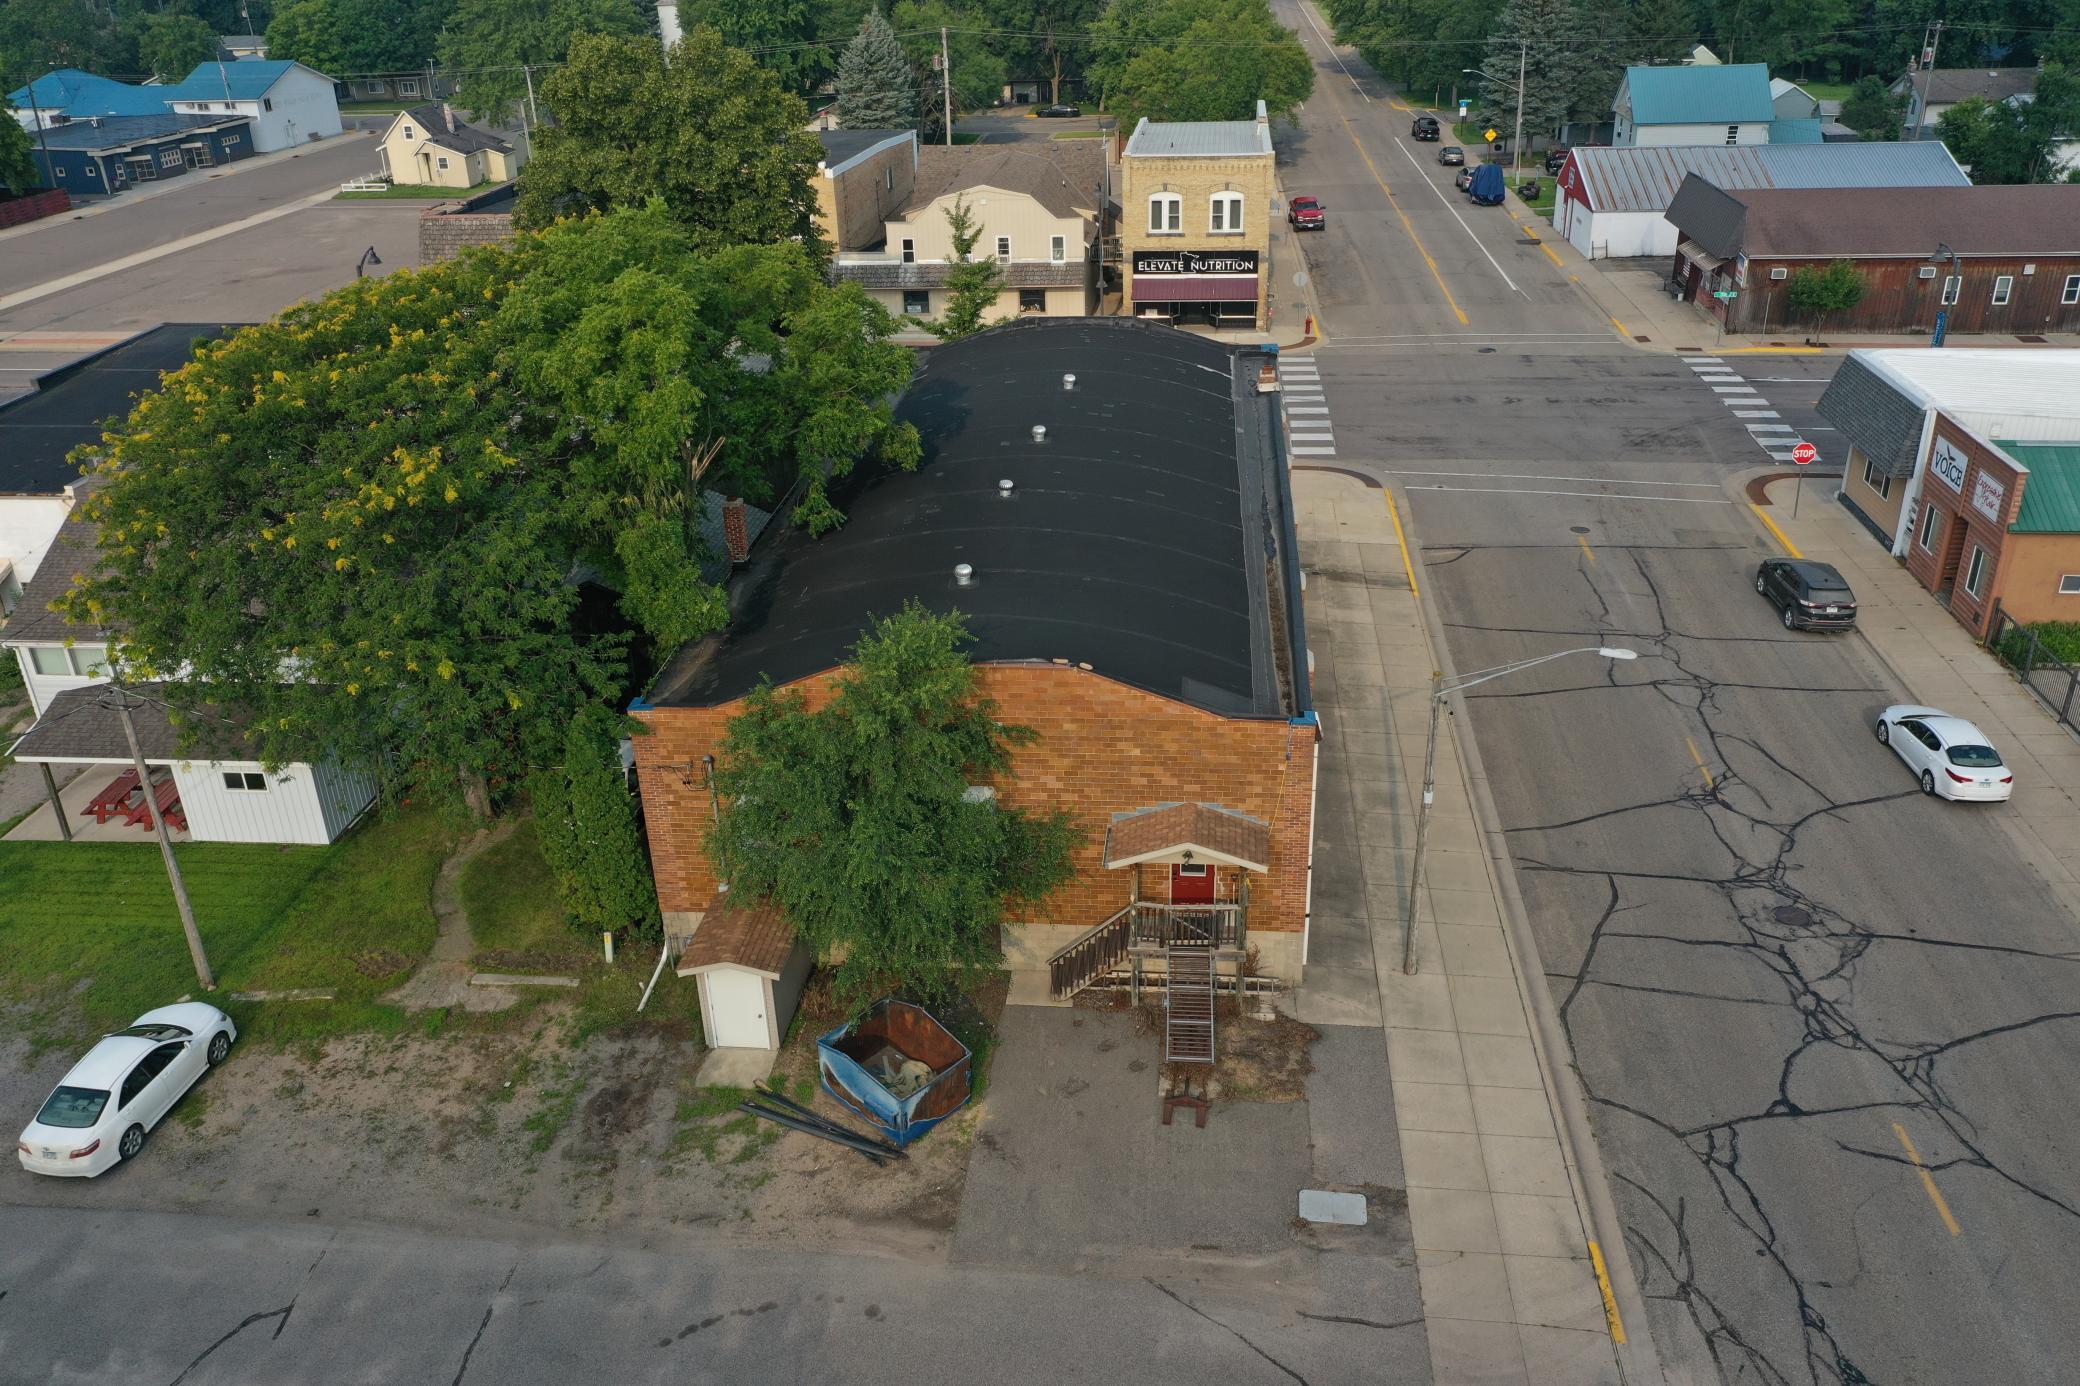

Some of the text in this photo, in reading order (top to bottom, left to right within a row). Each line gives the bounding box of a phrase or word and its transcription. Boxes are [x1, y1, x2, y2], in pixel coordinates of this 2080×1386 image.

[1138, 261, 1254, 271] ELEVATE NUTRITION
[1794, 449, 1814, 458] STOP
[1935, 450, 1963, 487] VOICE
